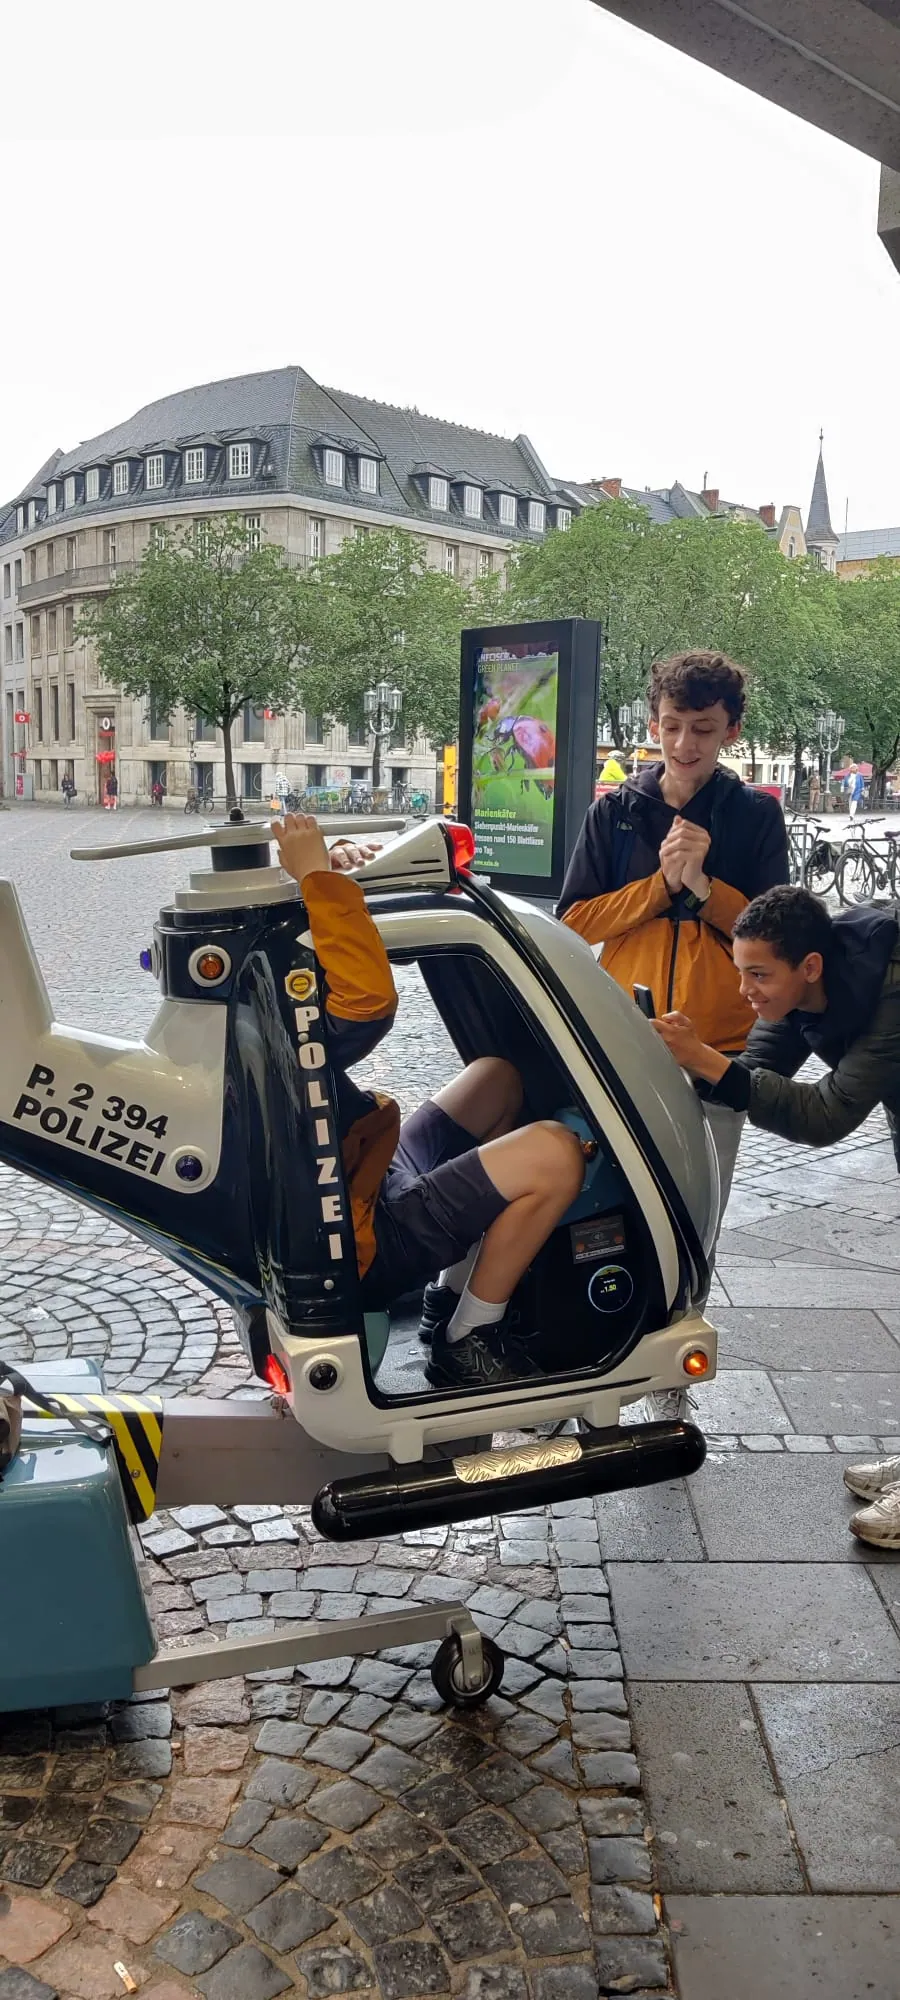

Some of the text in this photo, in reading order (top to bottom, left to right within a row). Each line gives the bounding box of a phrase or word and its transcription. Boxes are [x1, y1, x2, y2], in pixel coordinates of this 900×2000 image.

[477, 662, 521, 674] GREEN PLANET
[474, 808, 517, 819] Marienkäfer
[474, 821, 539, 833] Siebenpunkt-Marienkäfer
[493, 835, 506, 843] rund
[507, 835, 516, 844] 150
[517, 836, 544, 846] Blattläuse
[26, 1063, 170, 1140] P. 2 394
[12, 1094, 167, 1176] POLIZEI
[294, 1005, 344, 1260] POLIZEI
